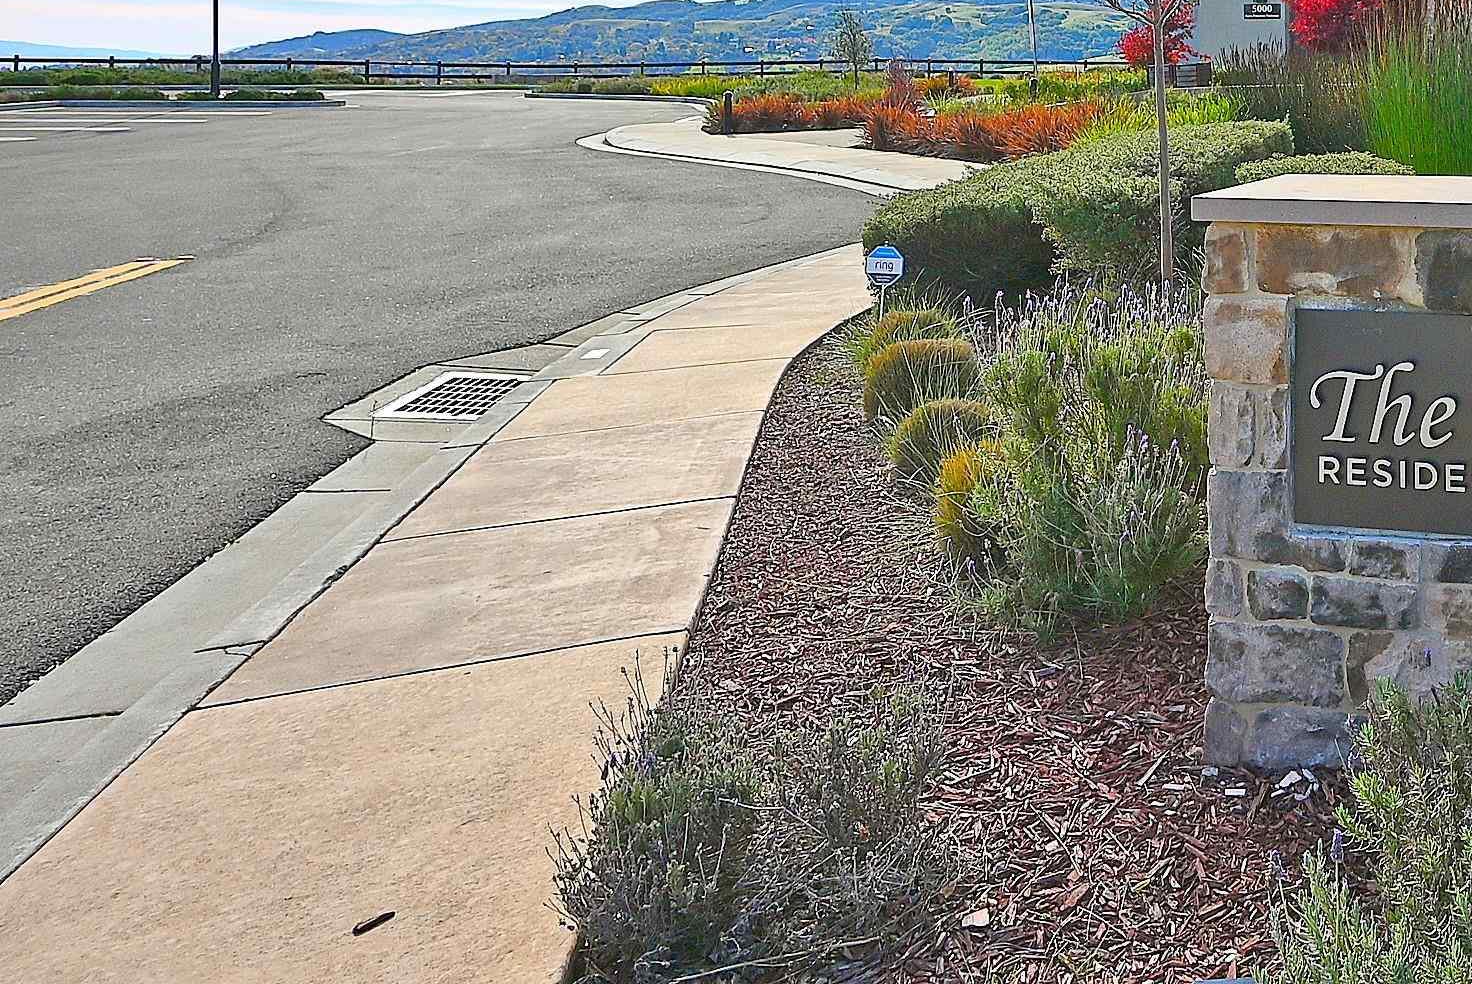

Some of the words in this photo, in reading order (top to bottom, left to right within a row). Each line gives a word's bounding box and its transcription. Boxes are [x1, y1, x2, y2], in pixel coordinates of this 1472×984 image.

[1251, 4, 1273, 13] 5000
[874, 261, 894, 272] ring
[1309, 361, 1456, 448] The
